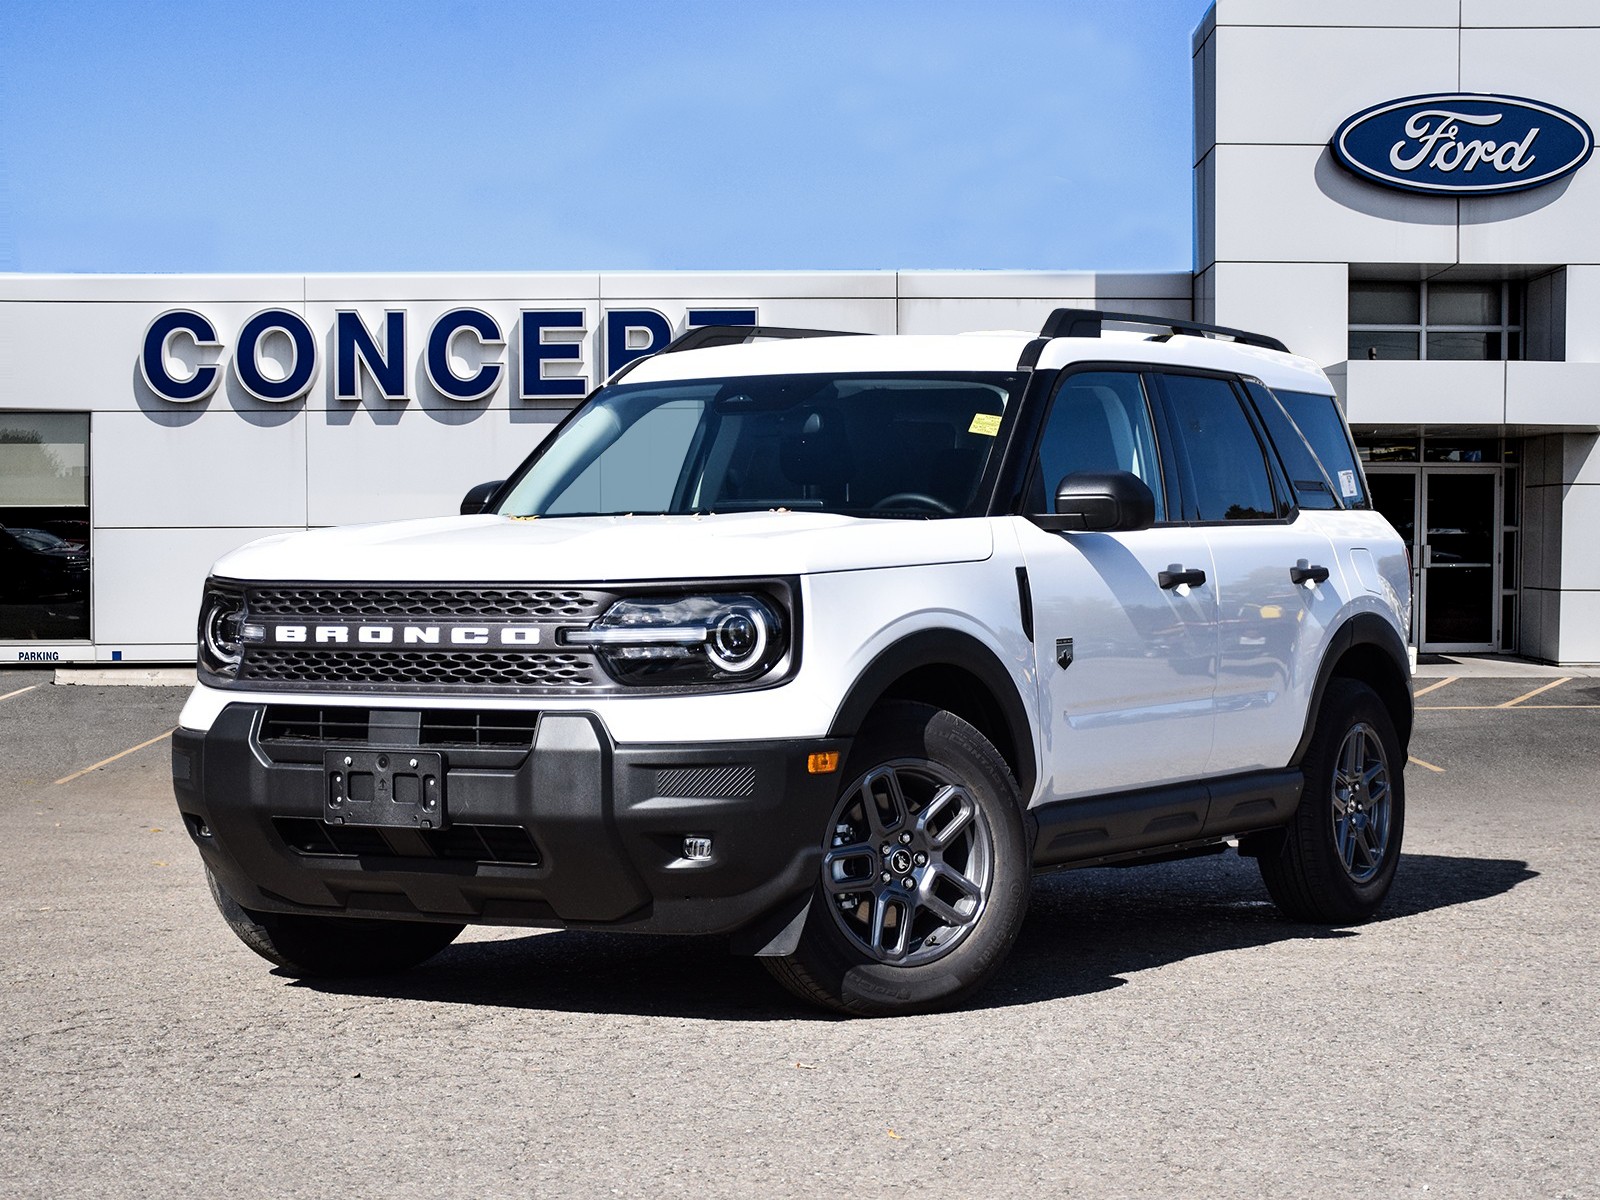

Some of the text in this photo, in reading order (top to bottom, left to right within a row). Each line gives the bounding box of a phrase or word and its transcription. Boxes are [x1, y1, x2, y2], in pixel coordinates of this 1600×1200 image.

[1389, 110, 1540, 173] Ford
[275, 625, 540, 645] BRONCO
[18, 651, 59, 661] PARKING
